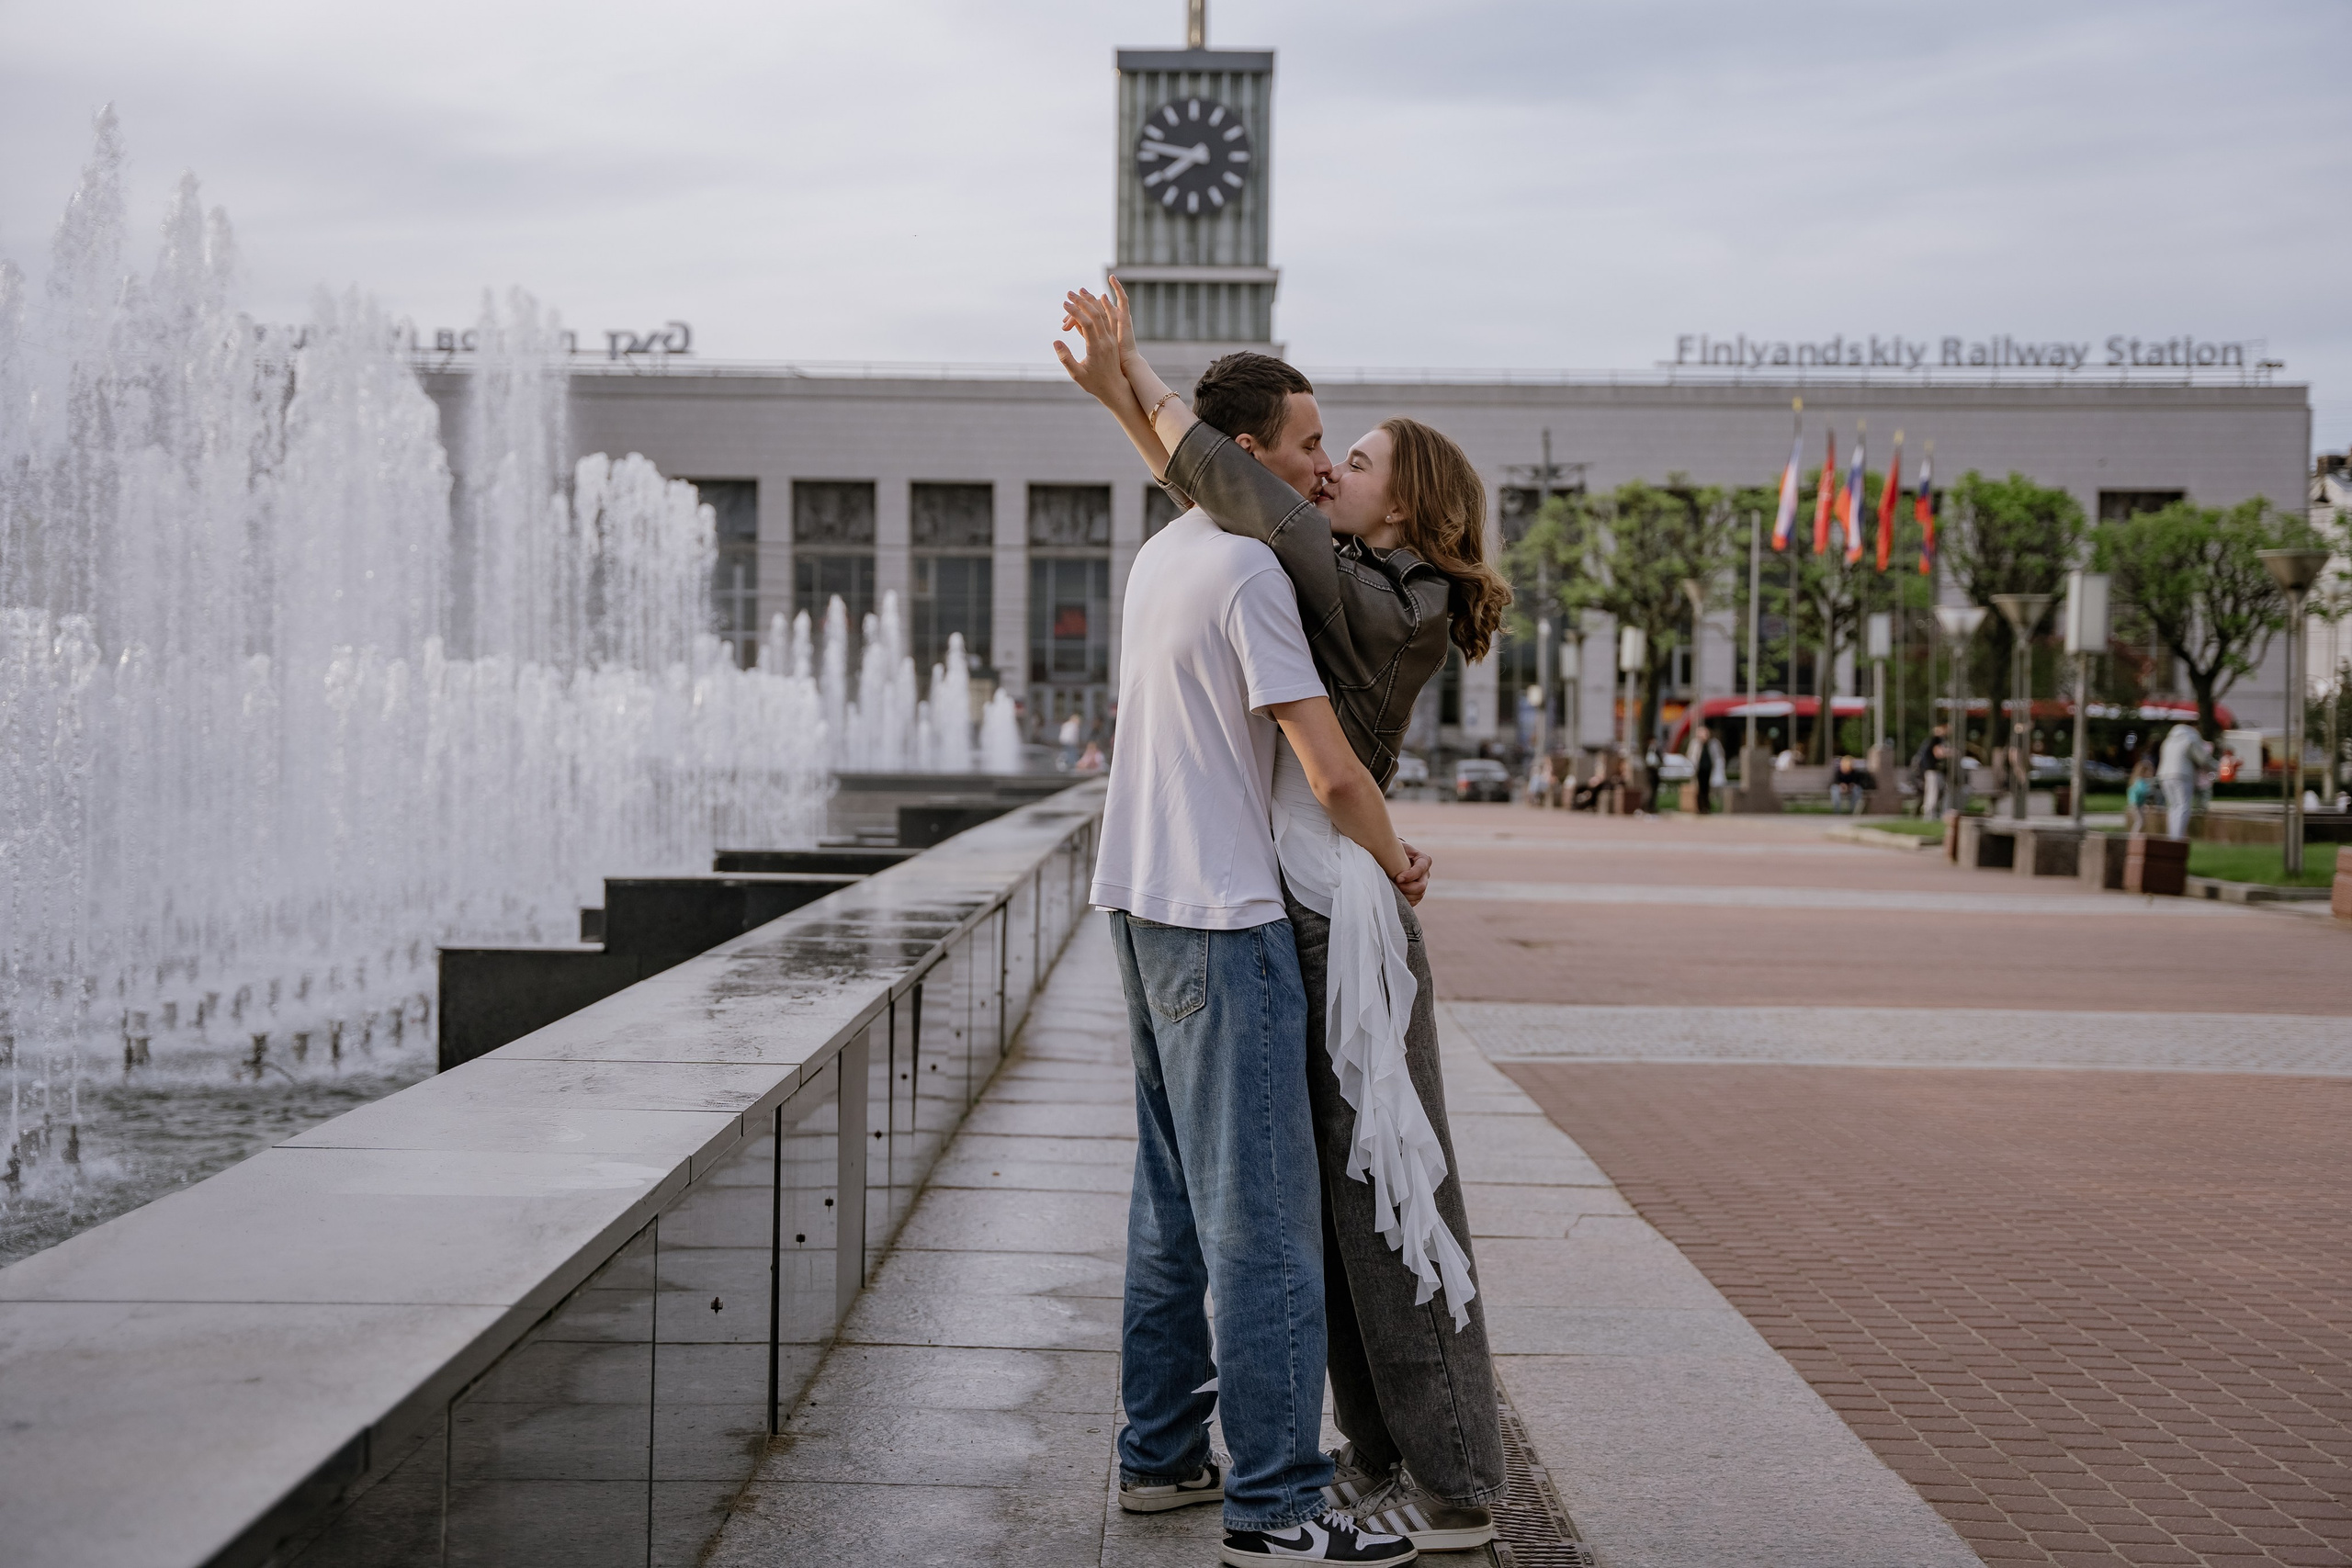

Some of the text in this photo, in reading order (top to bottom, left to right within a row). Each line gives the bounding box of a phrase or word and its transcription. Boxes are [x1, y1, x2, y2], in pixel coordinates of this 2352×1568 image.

[1675, 332, 2244, 369] Finlyandskiy Railway Station
